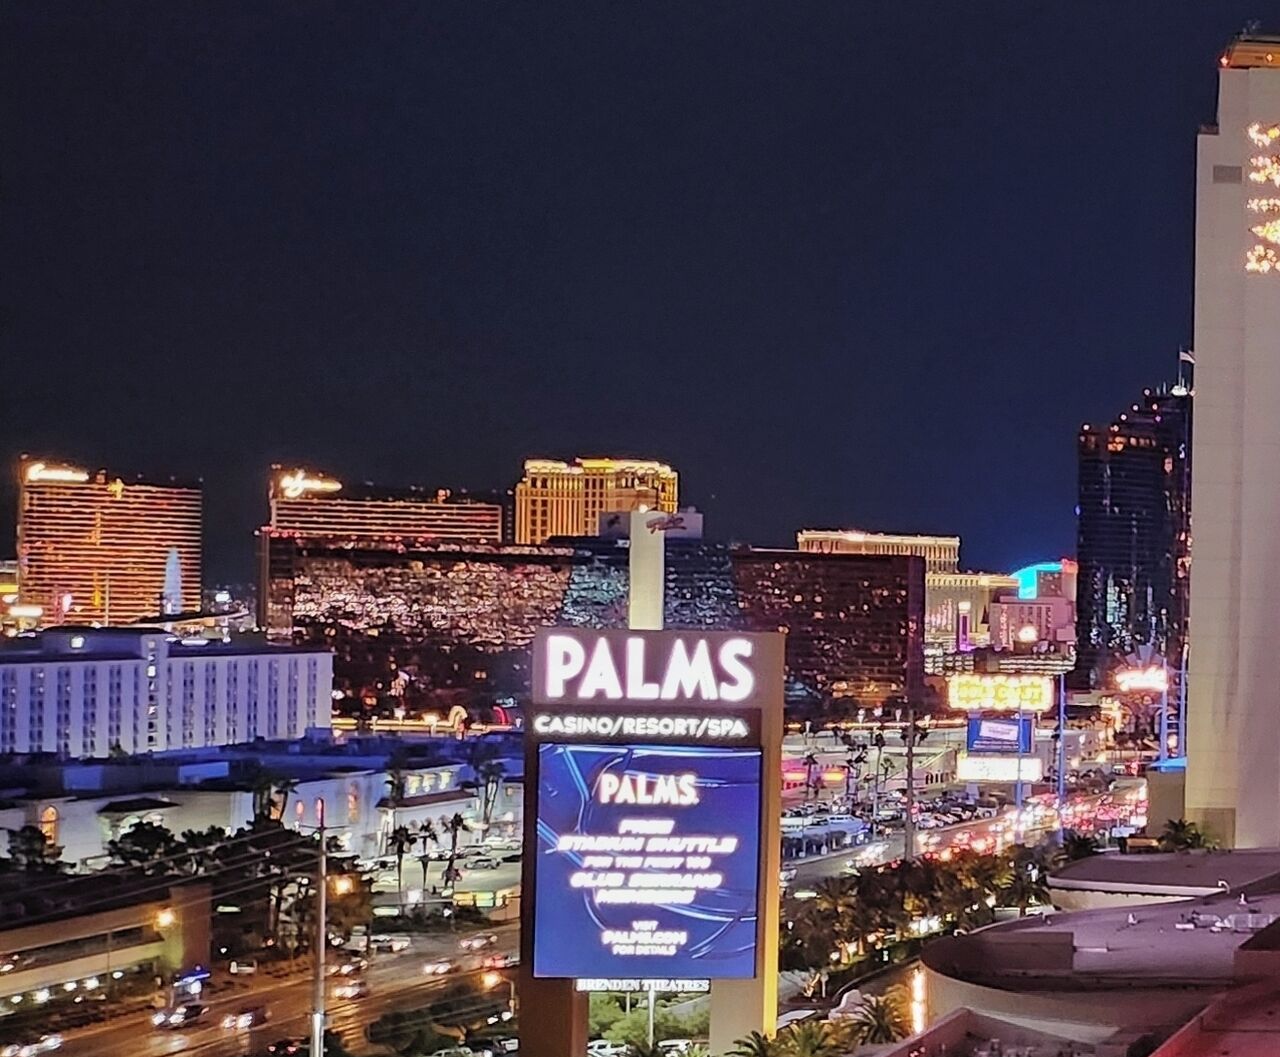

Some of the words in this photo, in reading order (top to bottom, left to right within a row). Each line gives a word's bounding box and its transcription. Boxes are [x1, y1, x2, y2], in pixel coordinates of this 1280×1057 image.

[546, 635, 754, 701] PALMS
[534, 715, 748, 738] CASINO/RESORT/SPA
[576, 978, 640, 992] BRENDEN
[641, 978, 710, 992] THEATRES
